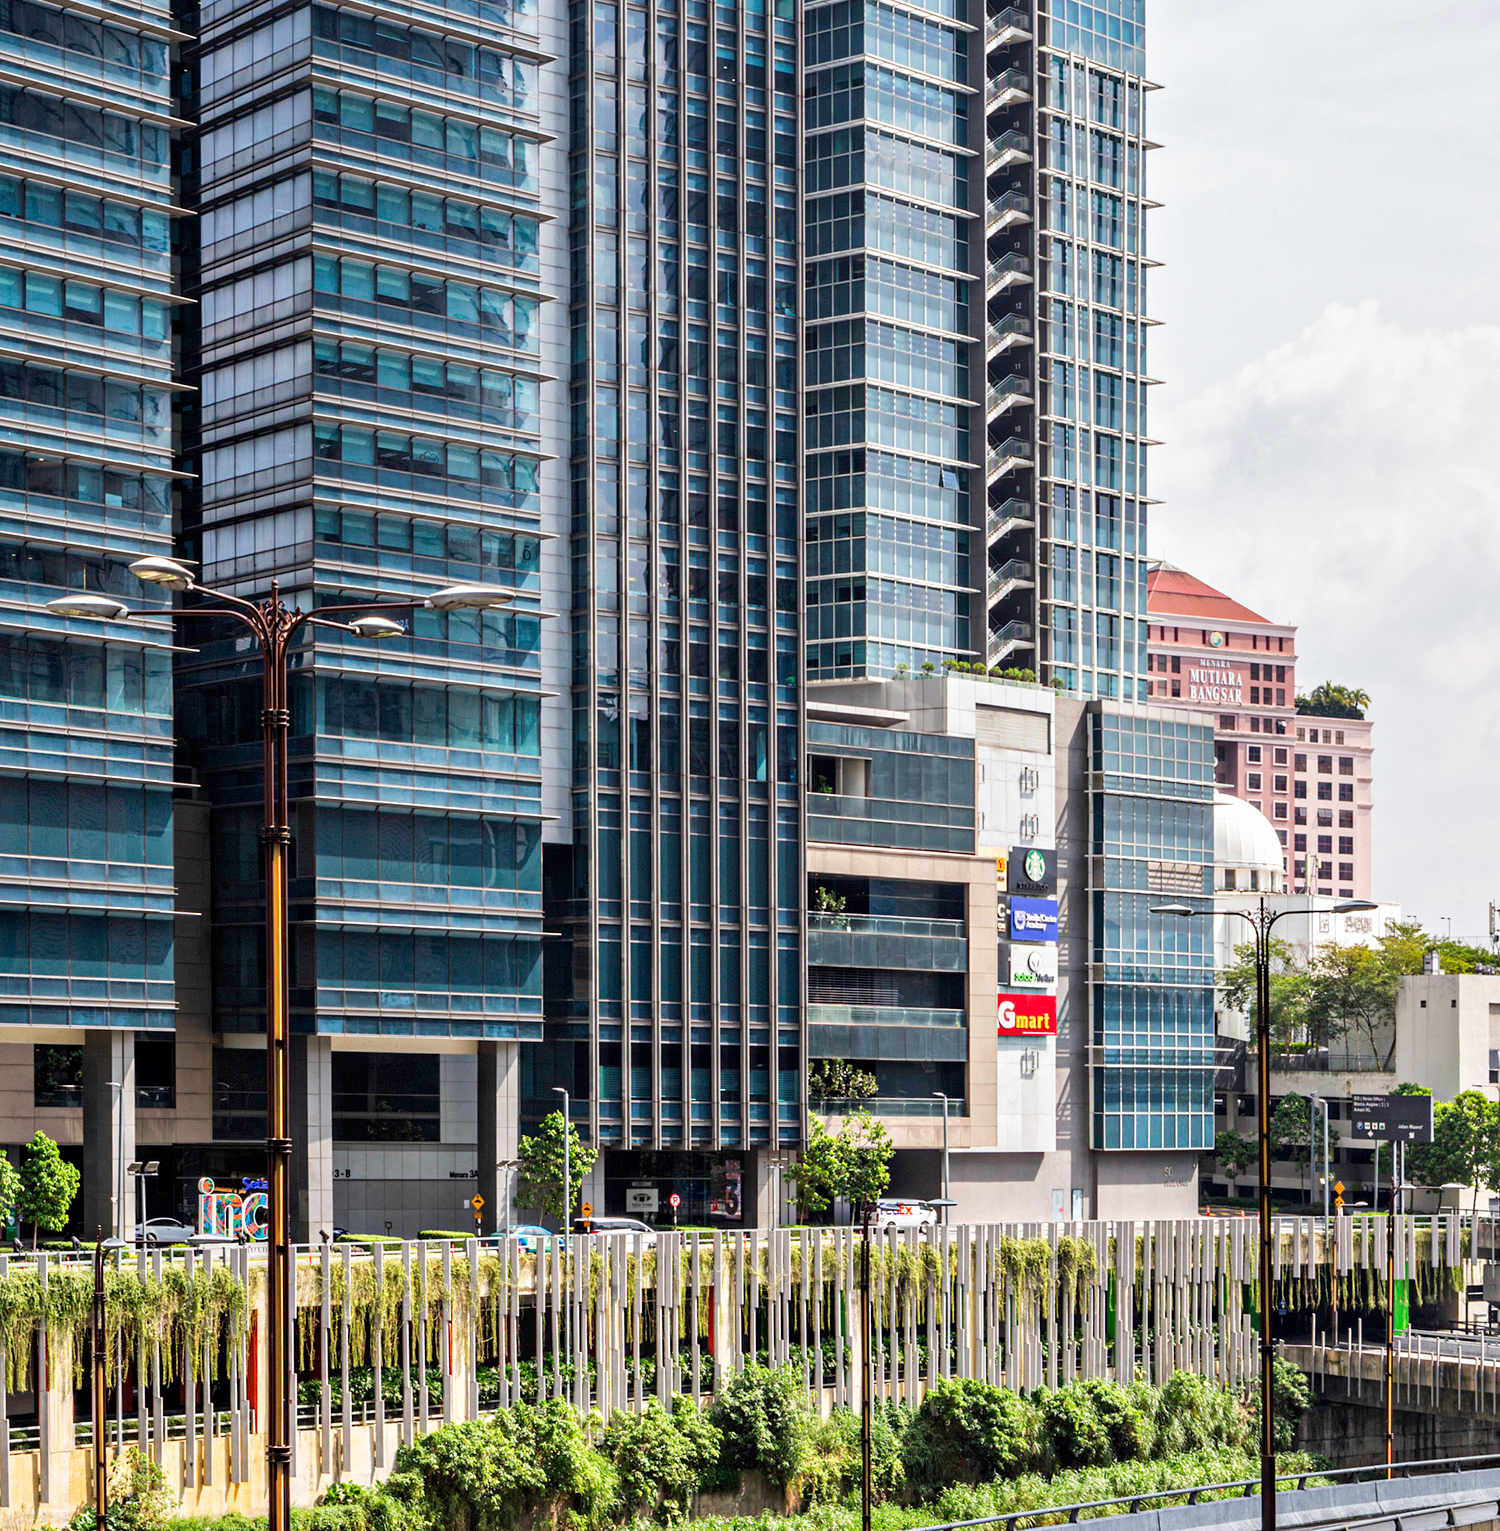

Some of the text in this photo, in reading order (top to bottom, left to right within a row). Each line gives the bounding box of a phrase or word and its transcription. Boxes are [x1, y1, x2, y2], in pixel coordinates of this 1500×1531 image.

[1200, 658, 1231, 669] MENARA
[1190, 669, 1243, 687] MUTIARA
[1190, 685, 1243, 703] BANGSAR
[997, 1001, 1050, 1029] Gmart
